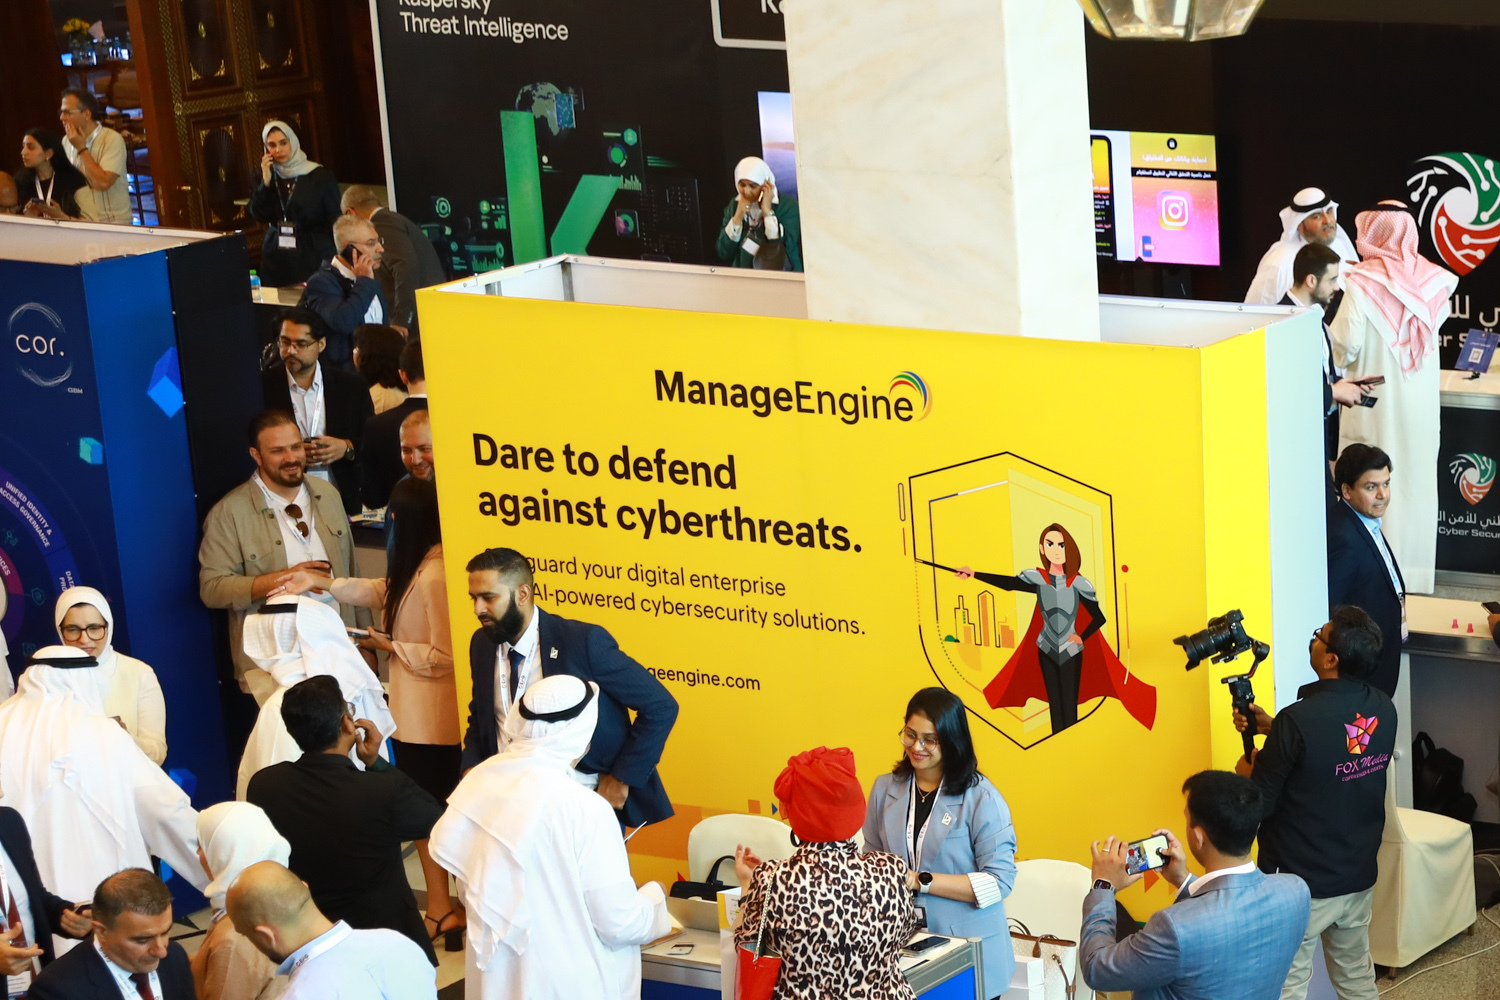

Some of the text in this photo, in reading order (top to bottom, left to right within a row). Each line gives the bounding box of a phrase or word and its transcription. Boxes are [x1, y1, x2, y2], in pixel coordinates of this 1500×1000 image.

[400, 12, 569, 43] Threat Intelligence
[16, 334, 64, 356] cor.
[654, 370, 914, 425] ManageEngine
[472, 432, 737, 490] Dare to defend
[0, 487, 51, 548] ACCESS GOVERNANCE
[6, 481, 52, 536] UNIFIED IDENTITY &
[478, 488, 862, 553] against cyberthreats.
[1438, 526, 1469, 536] Cyber
[1448, 510, 1476, 525] للأمن
[526, 556, 786, 598] guard your digital enterprise
[533, 583, 866, 635] AI-powered cybersecurity solutions.
[1336, 759, 1359, 775] FOX
